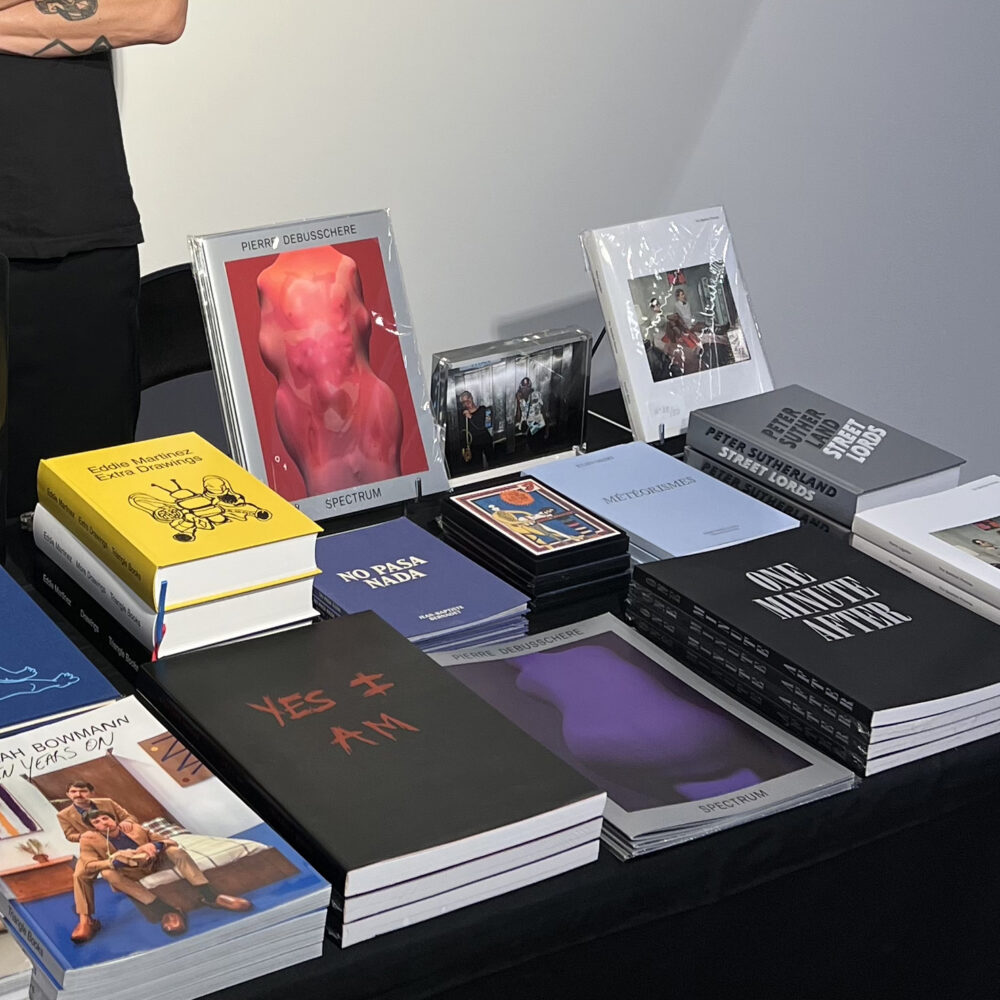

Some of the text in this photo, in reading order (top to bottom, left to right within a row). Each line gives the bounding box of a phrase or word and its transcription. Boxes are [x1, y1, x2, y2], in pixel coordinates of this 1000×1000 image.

[283, 224, 357, 246] DEBUSSCHERE
[761, 407, 801, 441] PETER
[778, 408, 826, 450] SUTHER
[804, 418, 841, 450] LAND
[823, 417, 869, 460] STREET
[87, 448, 194, 474] Eddie Martinez
[705, 426, 838, 498] PETER SUTHERLAND
[846, 424, 887, 464] LORDS
[94, 455, 203, 482] Extra Drawings
[718, 446, 816, 502] STREET LORDS
[47, 487, 76, 518] Eddie Martinez
[324, 487, 382, 510] SPECTRUM
[701, 461, 830, 533] PETER SUTHERLAND
[43, 530, 73, 563] Eddie Martinez
[336, 555, 428, 583] NO PASA
[364, 570, 427, 590] NADA
[745, 562, 818, 592] ONE
[752, 575, 880, 620] MINUTE
[802, 601, 912, 642] AFTER
[451, 628, 585, 662] PIERRE DEBUSSCHERE
[692, 604, 770, 658] MINUTE
[783, 662, 854, 712] AFTER
[246, 671, 395, 728] YES I
[33, 714, 131, 753] BOWMANN
[328, 712, 421, 757] AM
[19, 745, 78, 781] YEARS
[85, 731, 115, 751] ON
[698, 789, 769, 814] SPECTRUM
[7, 904, 44, 959] Triangle Books
